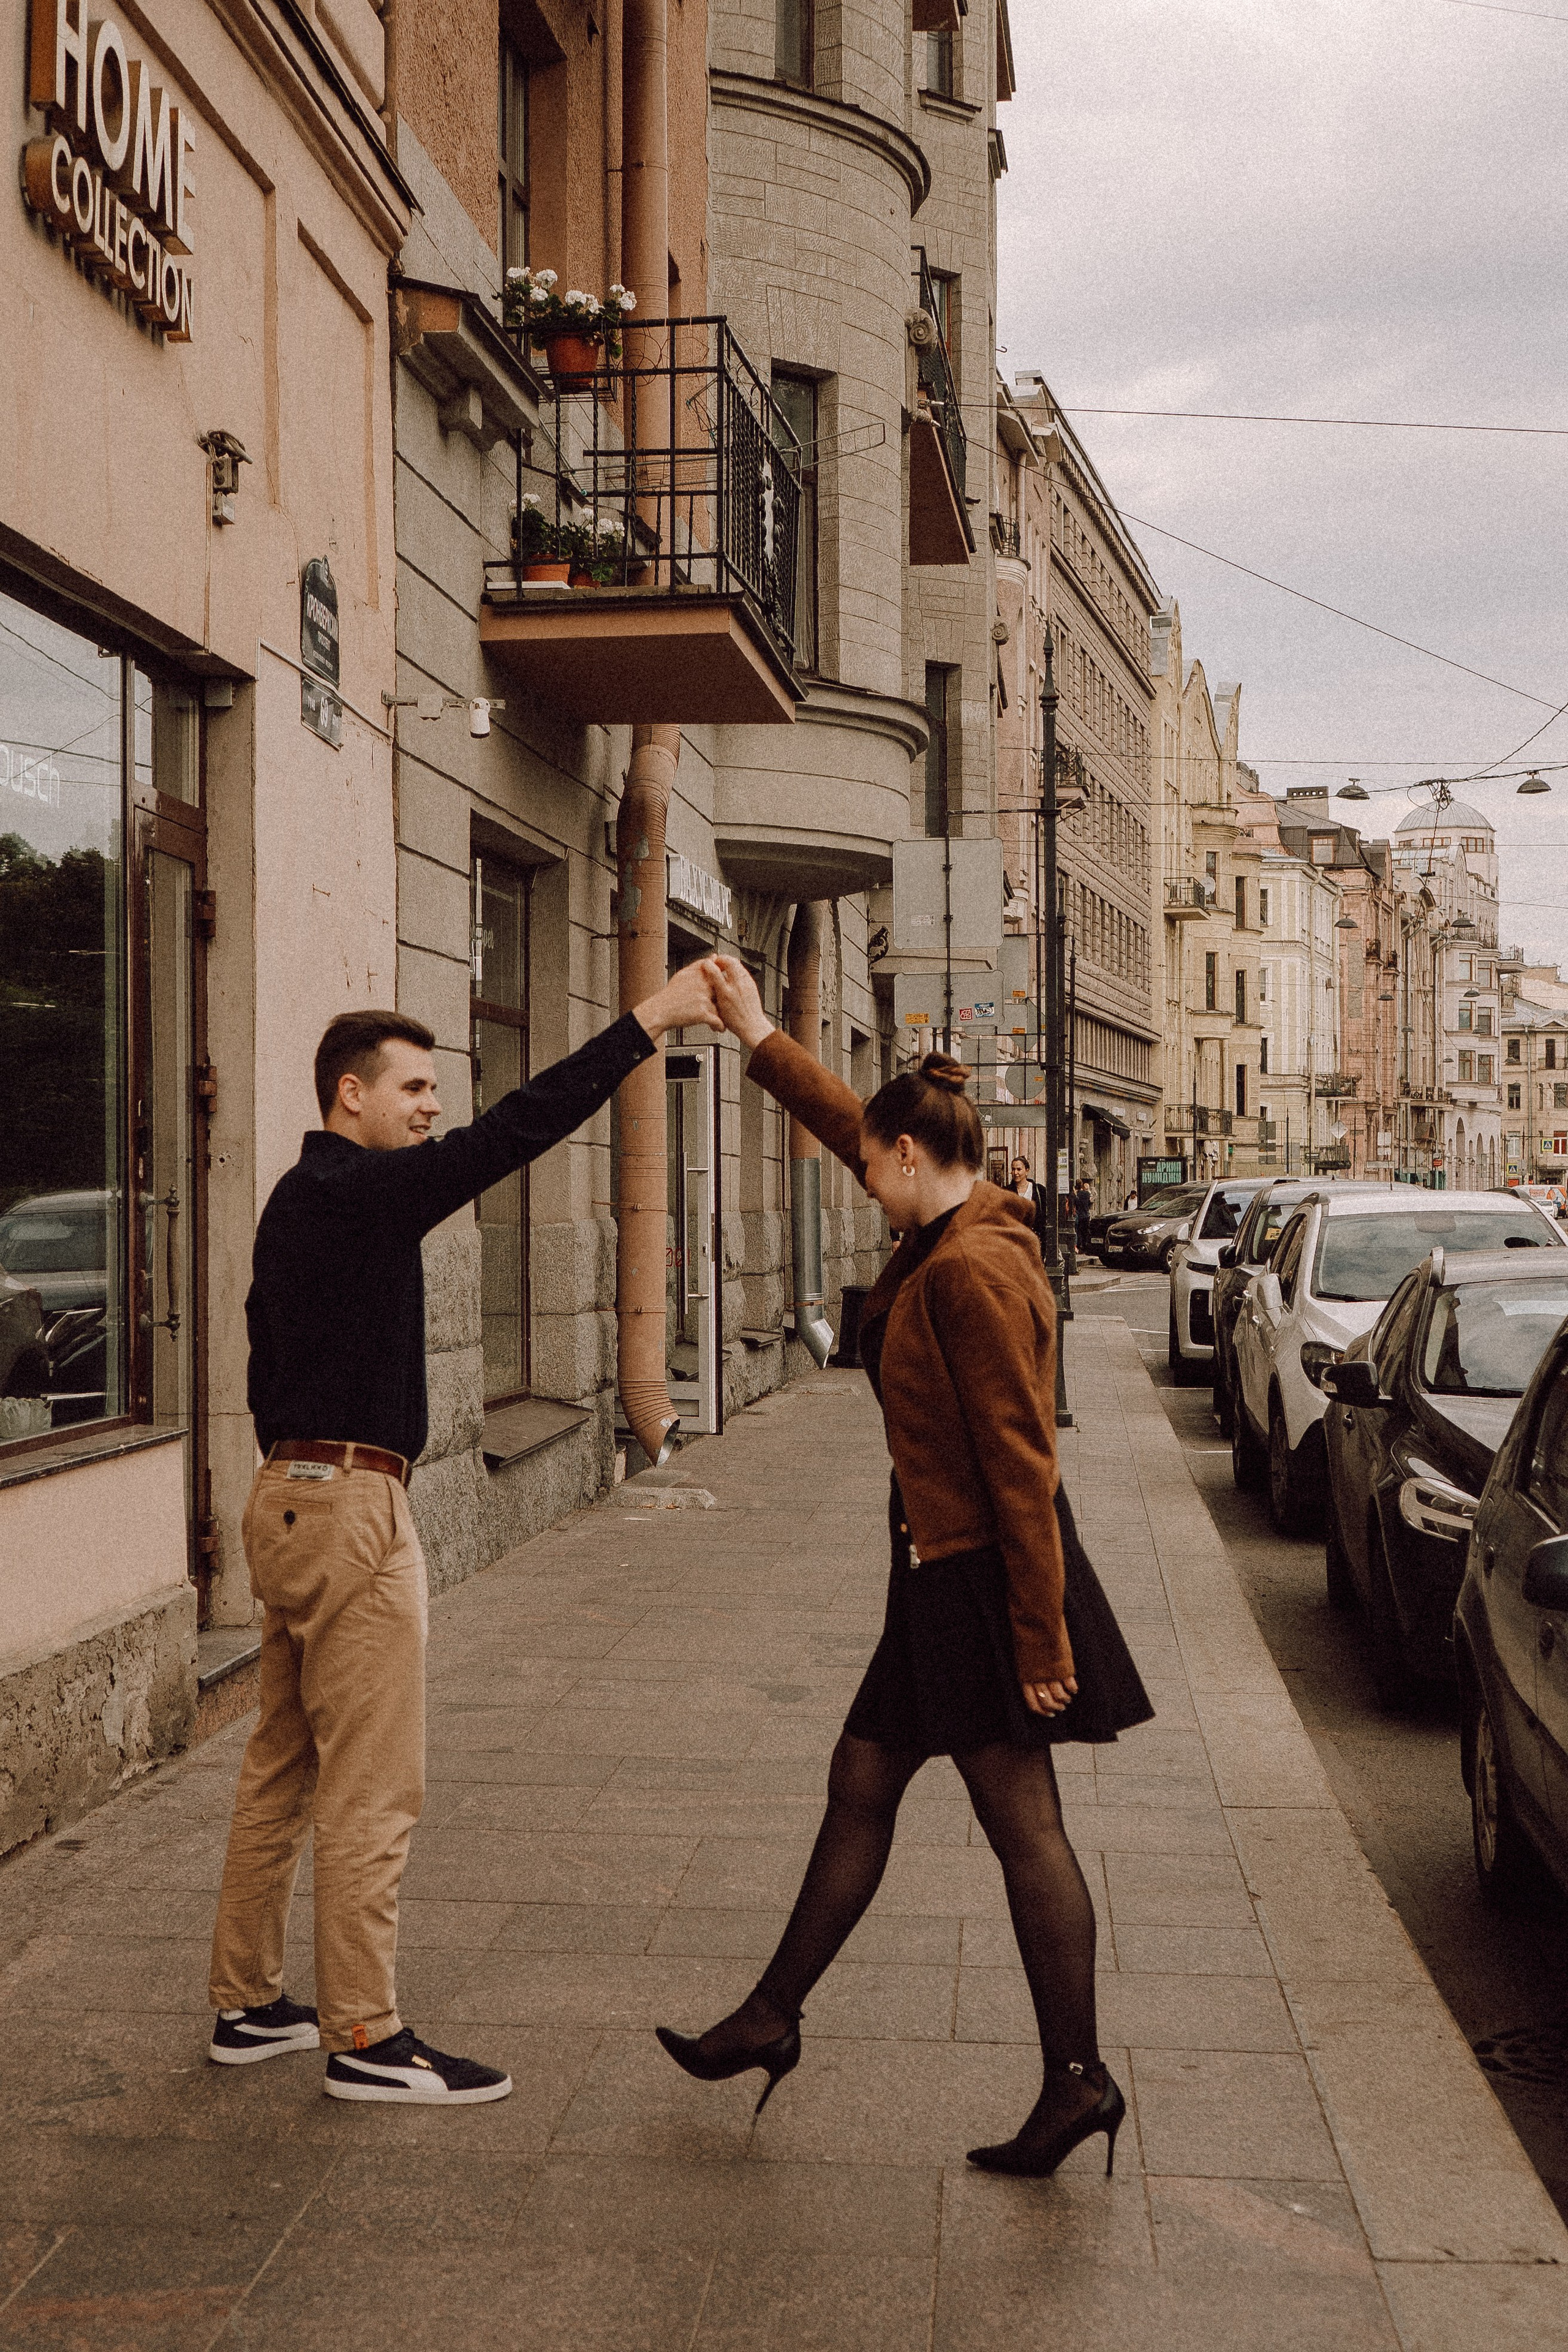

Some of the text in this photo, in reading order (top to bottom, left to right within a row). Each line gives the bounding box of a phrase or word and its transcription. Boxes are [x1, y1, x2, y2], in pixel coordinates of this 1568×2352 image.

[56, 0, 196, 255] HOME
[51, 136, 195, 342] COLLECTION
[320, 696, 328, 728] 69
[1142, 1172, 1182, 1183] КУИНДЖИ
